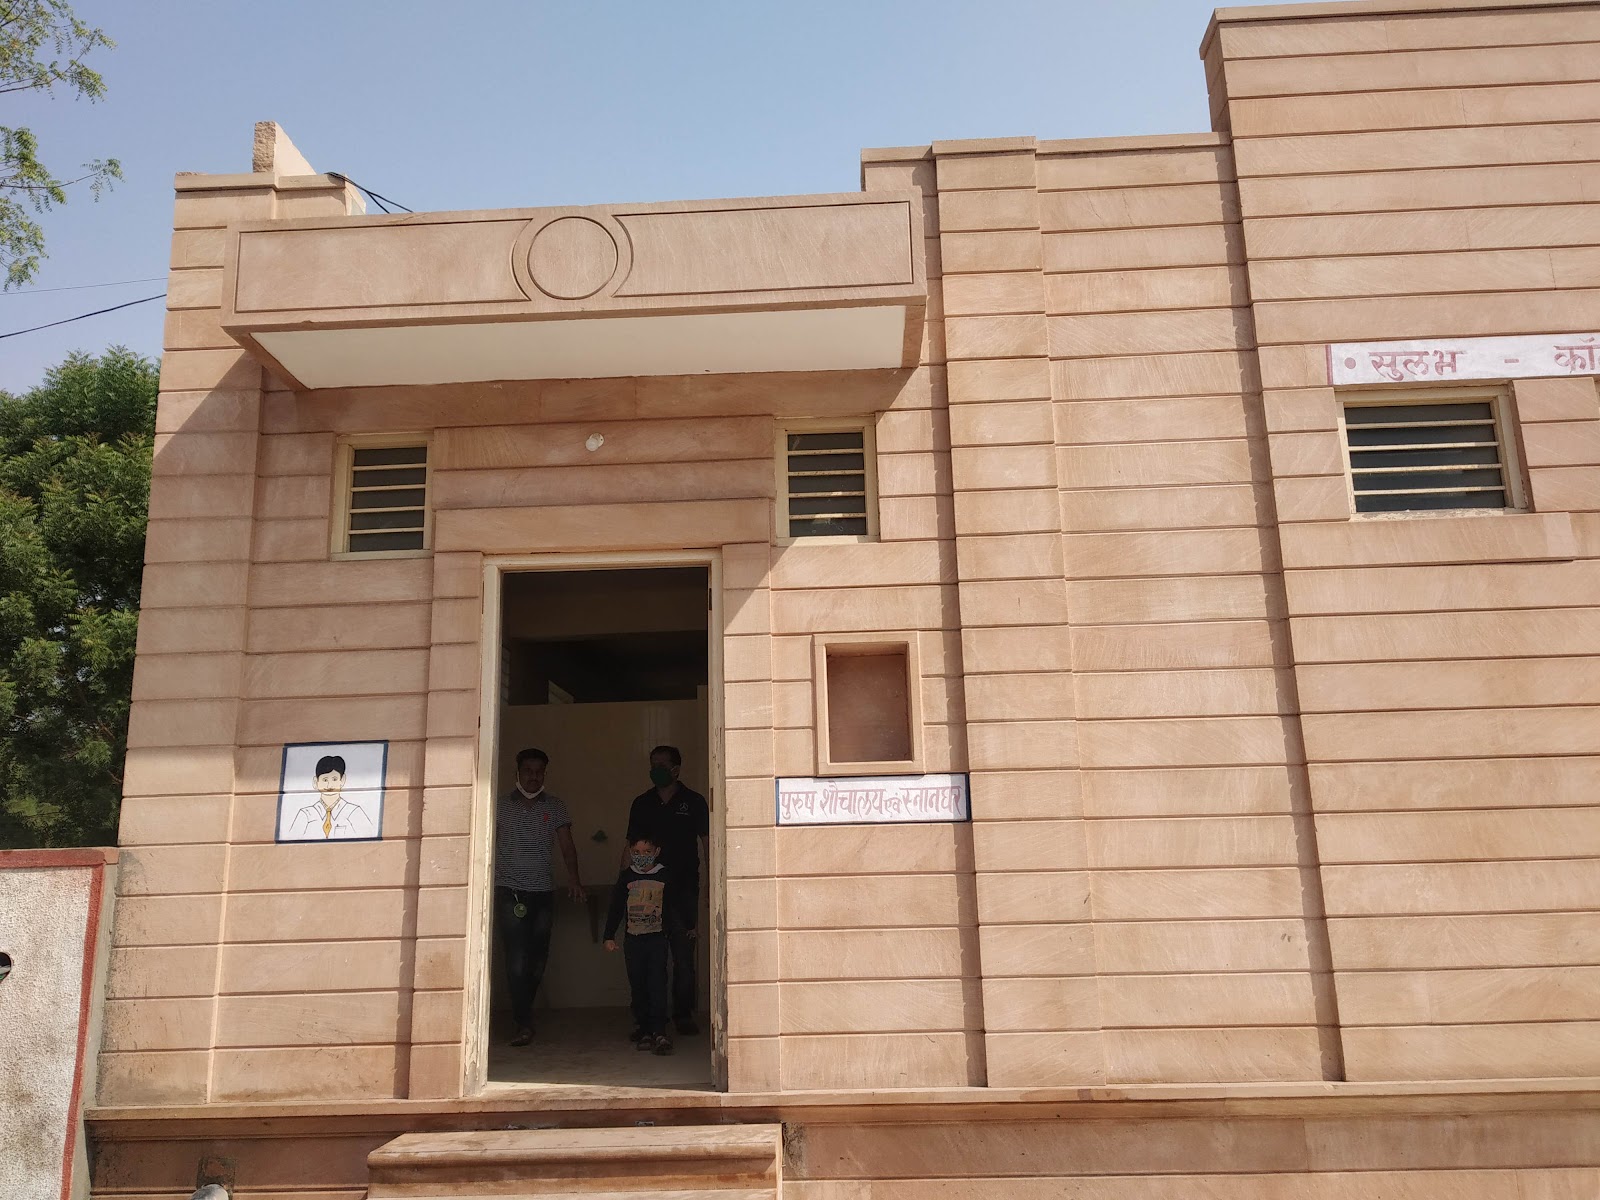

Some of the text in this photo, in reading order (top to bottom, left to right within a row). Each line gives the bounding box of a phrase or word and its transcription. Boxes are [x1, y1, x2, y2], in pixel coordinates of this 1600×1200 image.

[1369, 349, 1467, 382] सुलभ
[1553, 336, 1600, 374] कॉ
[780, 790, 817, 820] पुरुष
